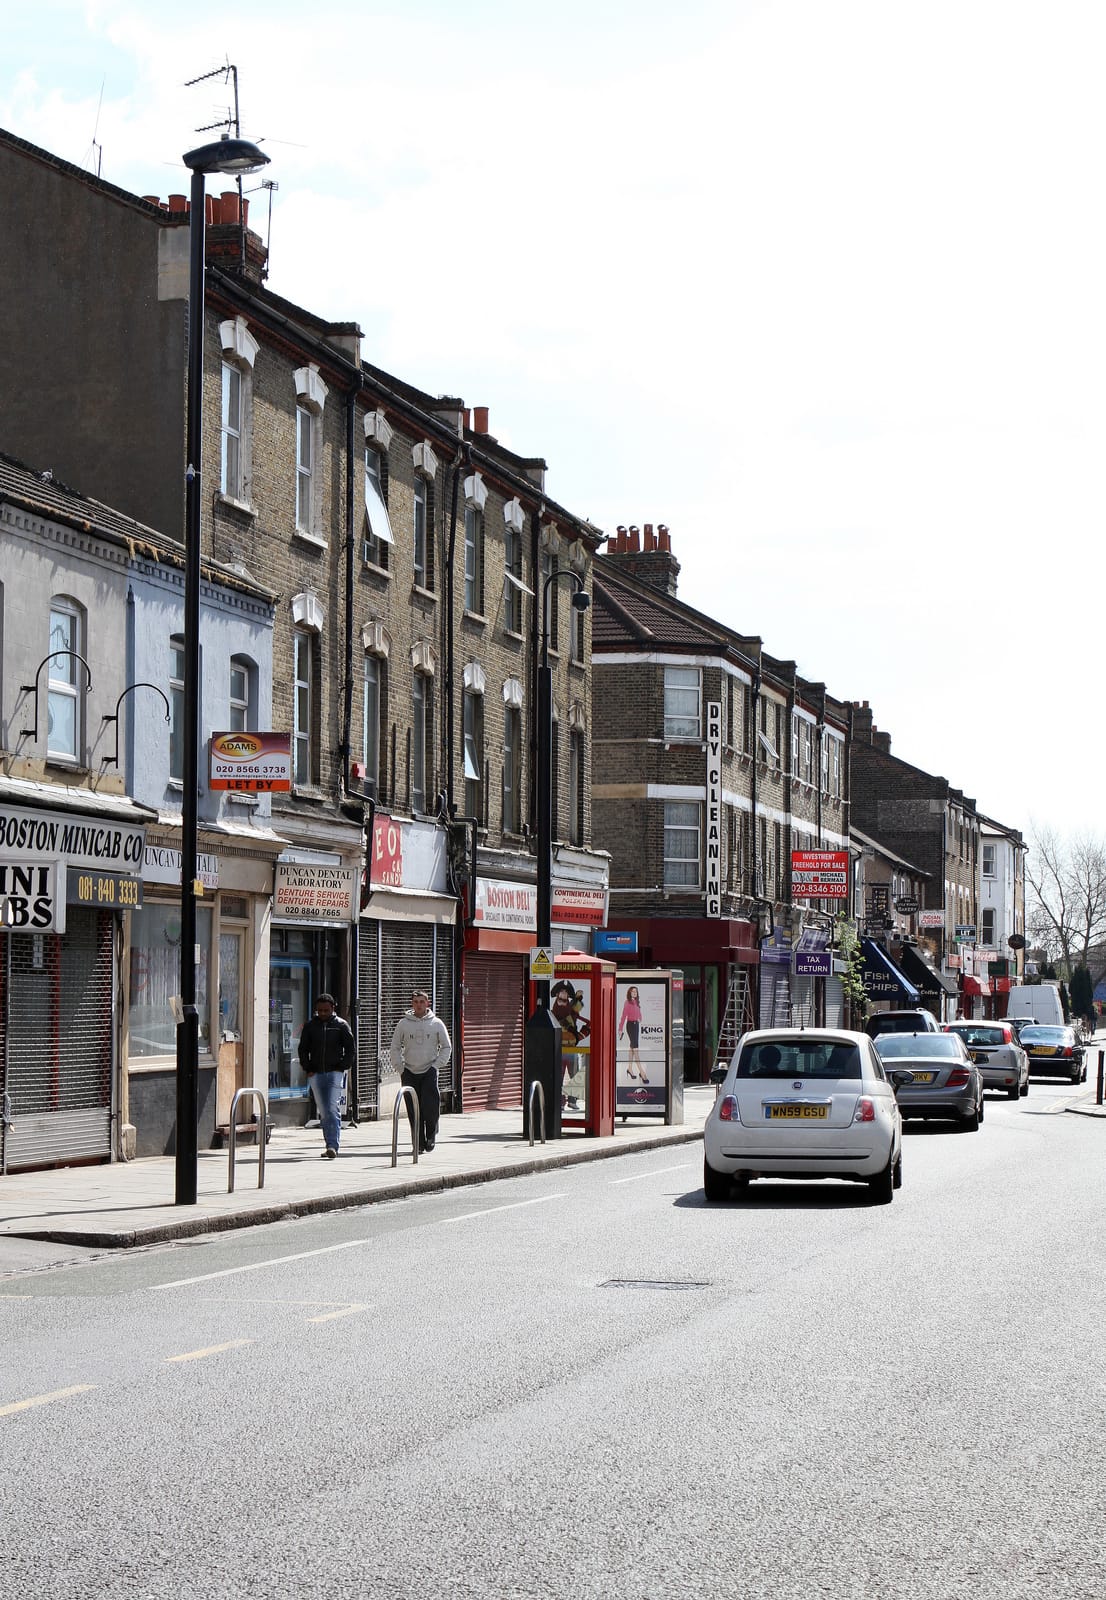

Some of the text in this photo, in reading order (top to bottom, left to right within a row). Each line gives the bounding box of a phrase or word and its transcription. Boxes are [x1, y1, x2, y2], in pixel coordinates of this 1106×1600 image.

[227, 780, 274, 789] LET BY
[709, 705, 719, 915] DRY CLEANING
[0, 816, 142, 862] BOSTON MINICAB CO
[145, 848, 175, 868] UNCAN
[793, 861, 820, 869] FREEHOLD
[280, 867, 352, 880] DUNCAN DENTAL
[382, 871, 402, 886] SAND
[0, 866, 50, 896] INI
[287, 877, 344, 889] LABORATORY
[118, 880, 138, 905] 3333
[278, 888, 350, 900] DENTURE SERVICE
[554, 889, 591, 898] CONTINENTAL
[829, 885, 847, 893] 5100
[277, 896, 350, 908] DENTURE REPAIRS
[487, 887, 530, 911] BOSTON DELI
[8, 897, 53, 928] BS
[301, 907, 320, 915] 8840
[322, 908, 341, 917] 7665
[864, 971, 890, 980] FISH
[863, 982, 900, 992] CHIPS
[641, 1026, 663, 1034] KING
[772, 1106, 801, 1117] WN59
